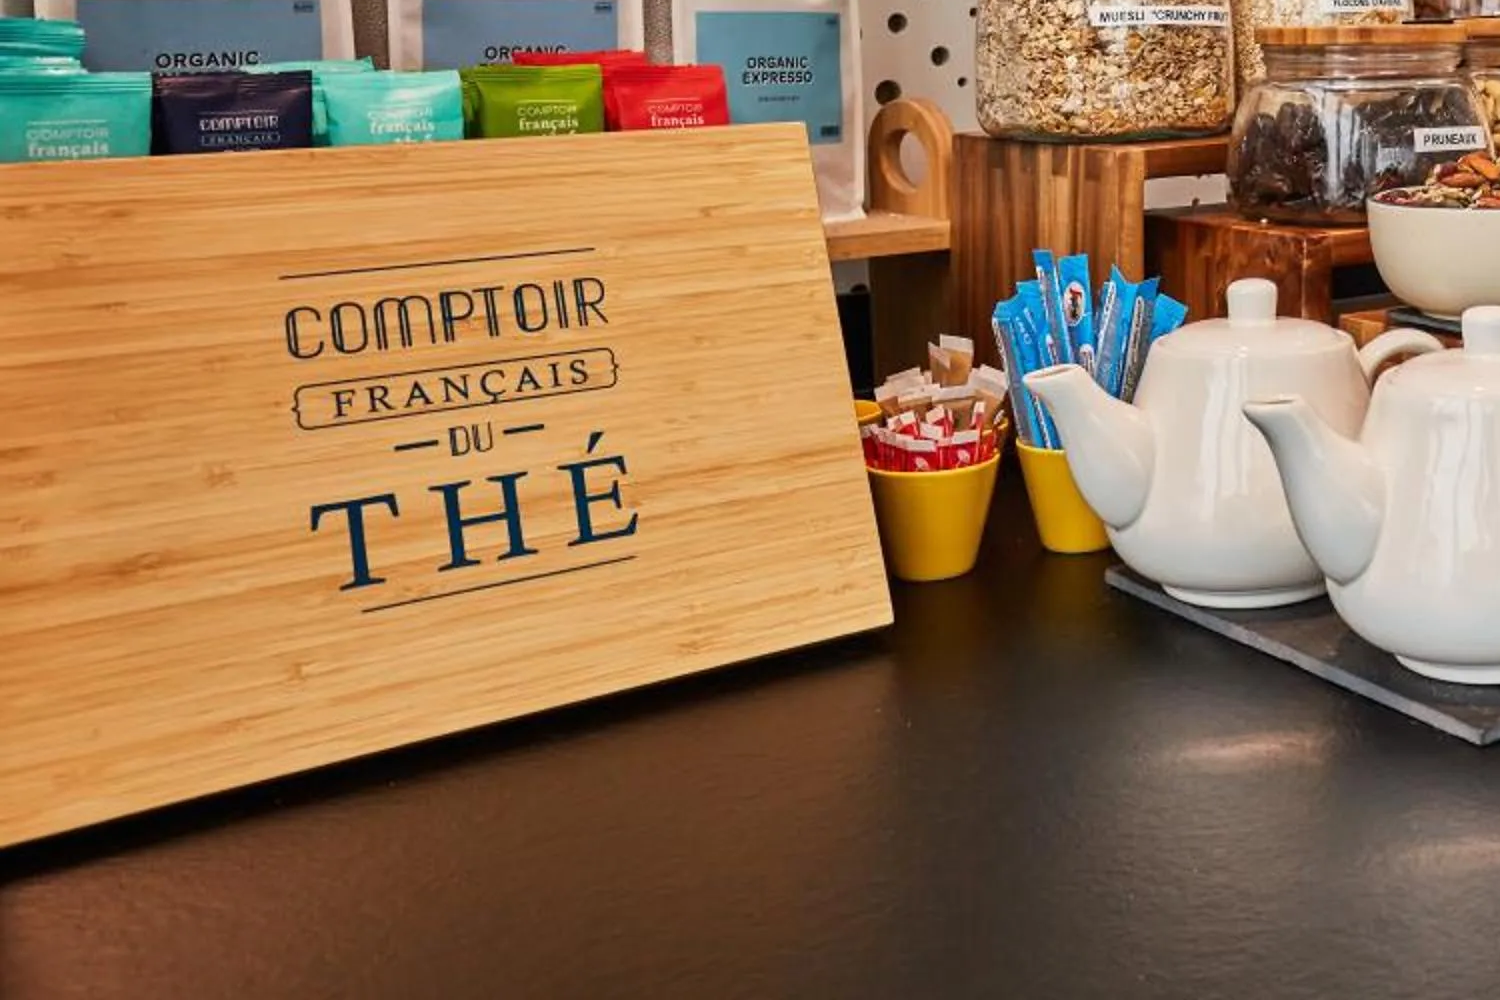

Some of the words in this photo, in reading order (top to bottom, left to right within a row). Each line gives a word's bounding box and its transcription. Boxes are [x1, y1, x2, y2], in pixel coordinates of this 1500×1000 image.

[1100, 10, 1145, 23] MUESLI
[155, 51, 259, 69] ORGANIC
[746, 56, 808, 69] ORGANIC
[742, 71, 813, 85] EXPRESSO
[199, 115, 279, 131] COMPTOIR
[369, 119, 435, 136] français
[519, 115, 579, 133] français
[651, 113, 705, 129] français
[1423, 133, 1477, 146] PRUNEAUX
[28, 140, 109, 160] français
[285, 276, 609, 360] COMPTOIR
[332, 357, 590, 419] FRANÇAIS
[448, 421, 494, 457] DU
[310, 431, 640, 592] THÉ
